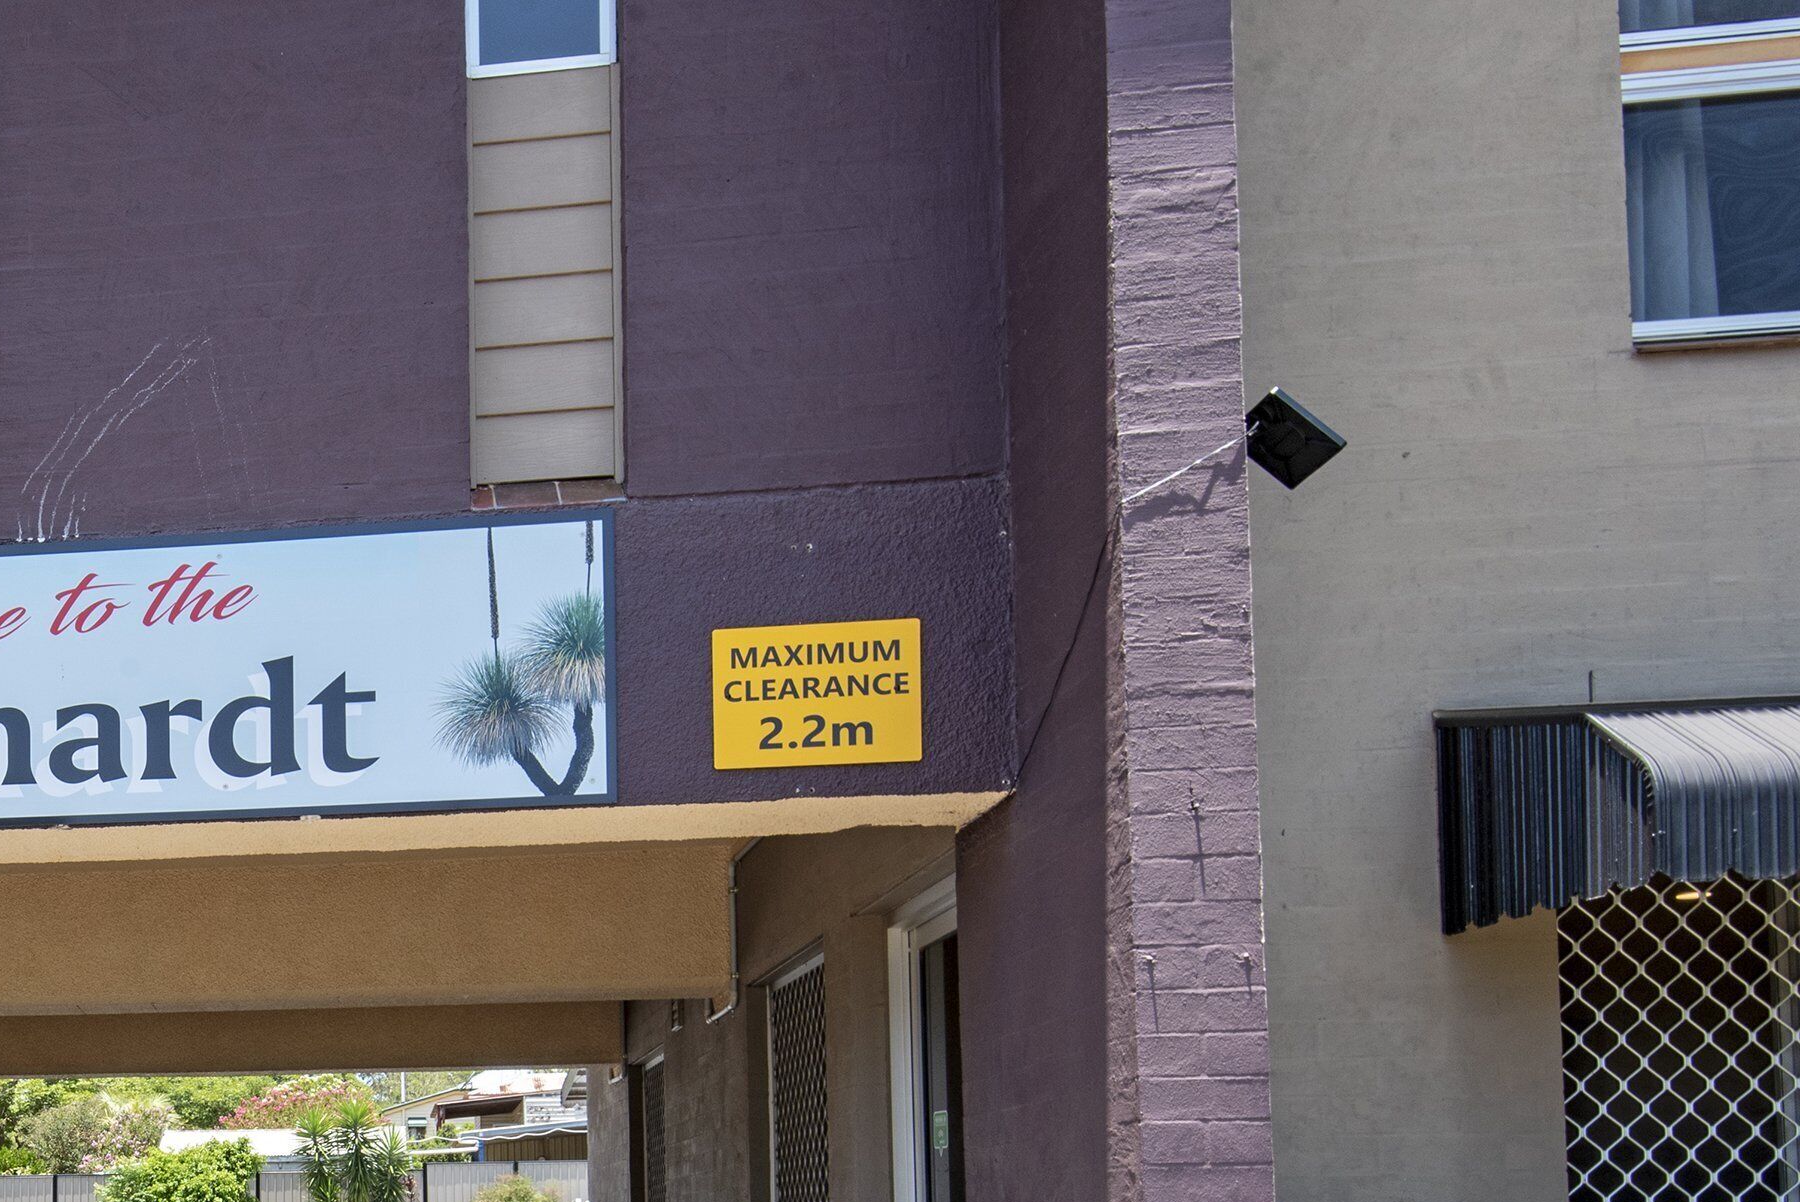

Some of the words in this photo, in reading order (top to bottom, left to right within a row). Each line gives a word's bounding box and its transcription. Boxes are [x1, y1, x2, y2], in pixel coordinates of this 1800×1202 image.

[50, 573, 136, 635] to
[142, 561, 258, 627] the
[730, 639, 901, 669] MAXIMUM
[723, 672, 910, 703] CLEARANCE
[758, 714, 874, 750] 2.2m
